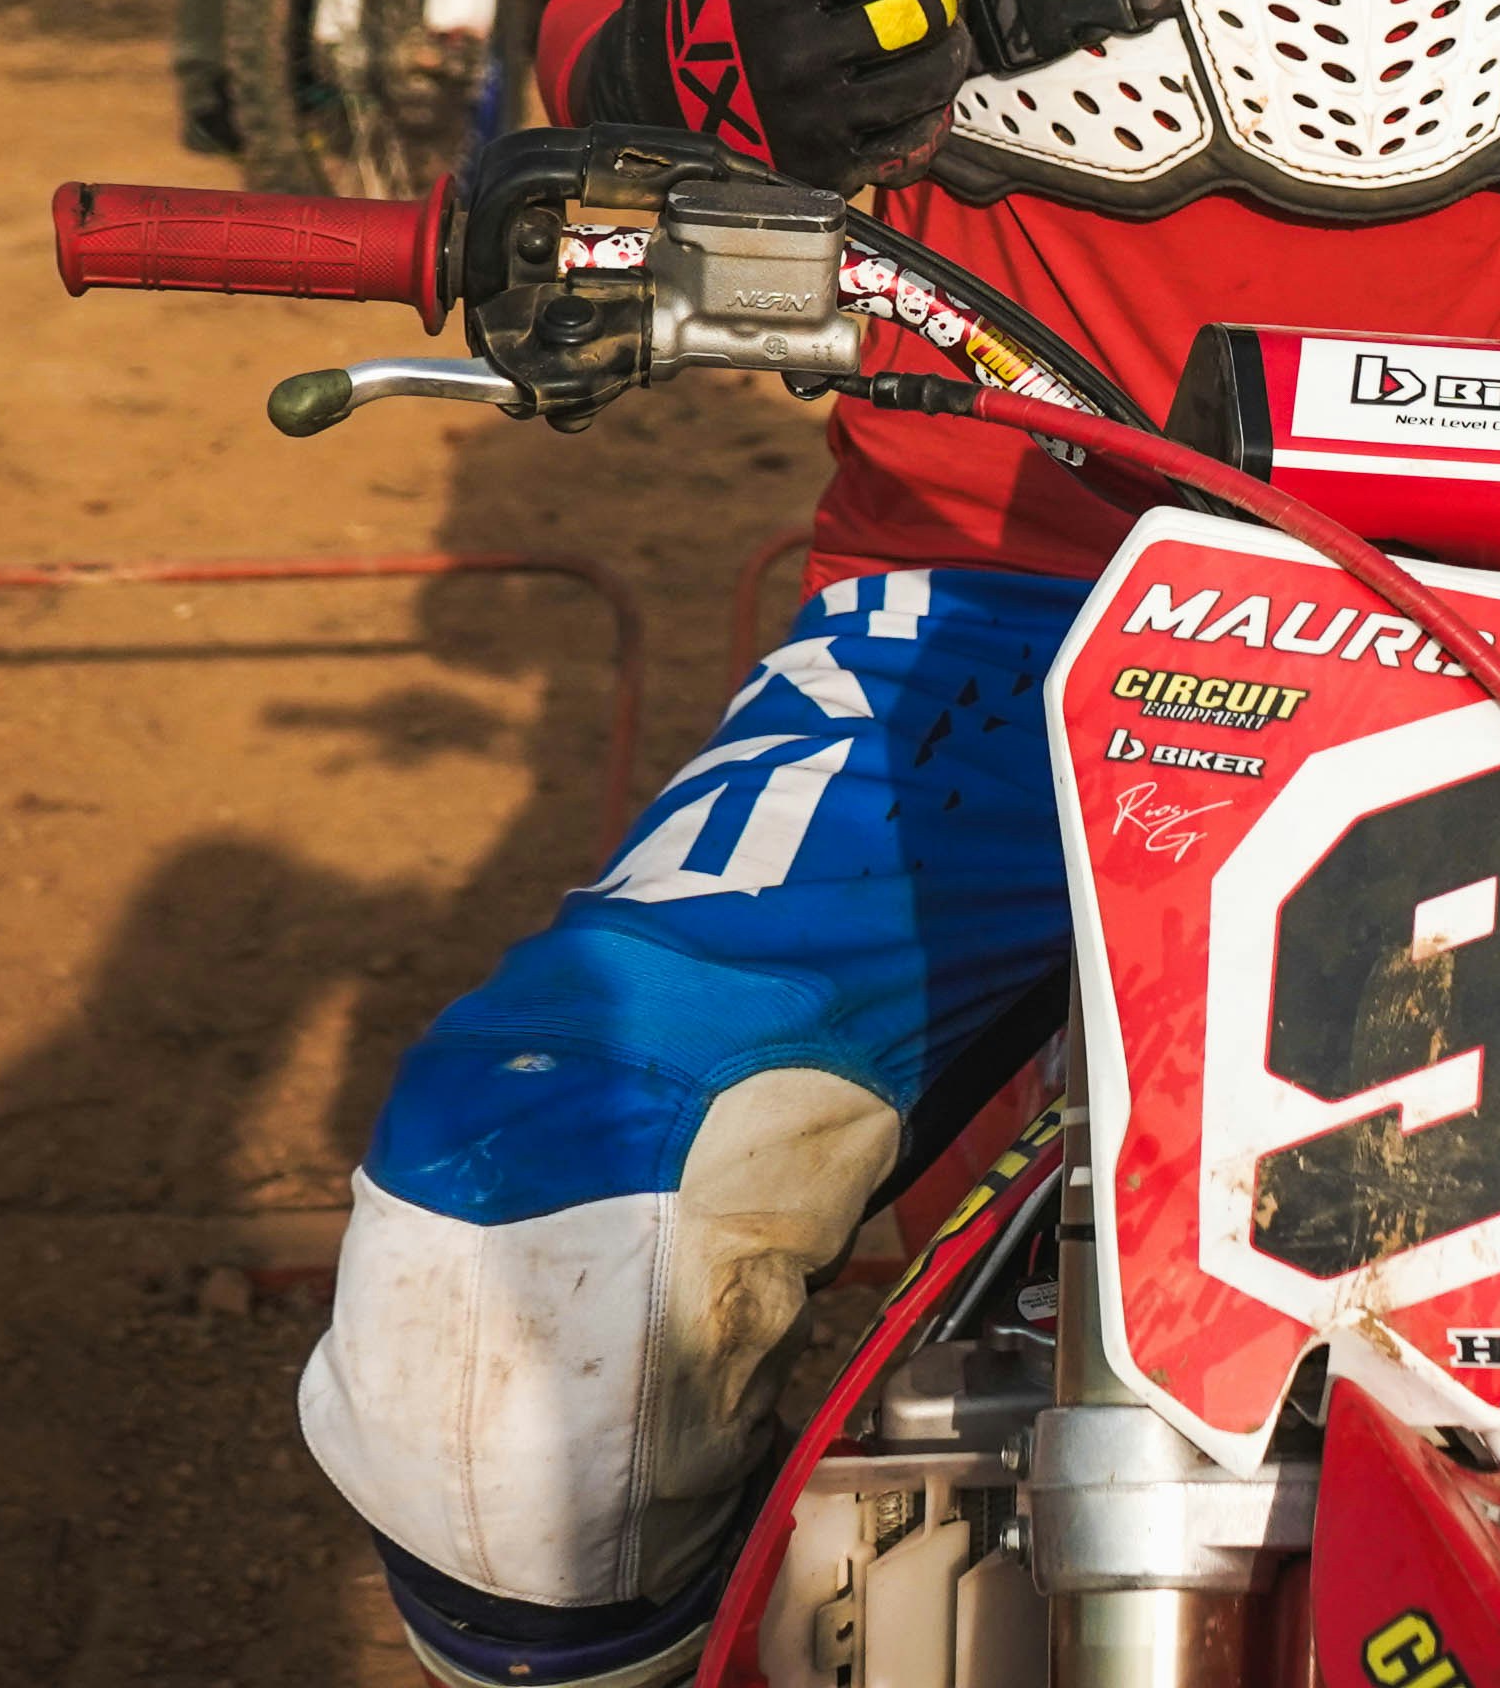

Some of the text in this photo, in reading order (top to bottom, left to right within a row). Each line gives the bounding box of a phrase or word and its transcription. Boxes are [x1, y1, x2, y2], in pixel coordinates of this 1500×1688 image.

[1395, 414, 1437, 427] Next
[1441, 418, 1488, 431] Level
[1112, 667, 1309, 720] CIRCUIT
[1141, 699, 1270, 731] EQUIPMENT
